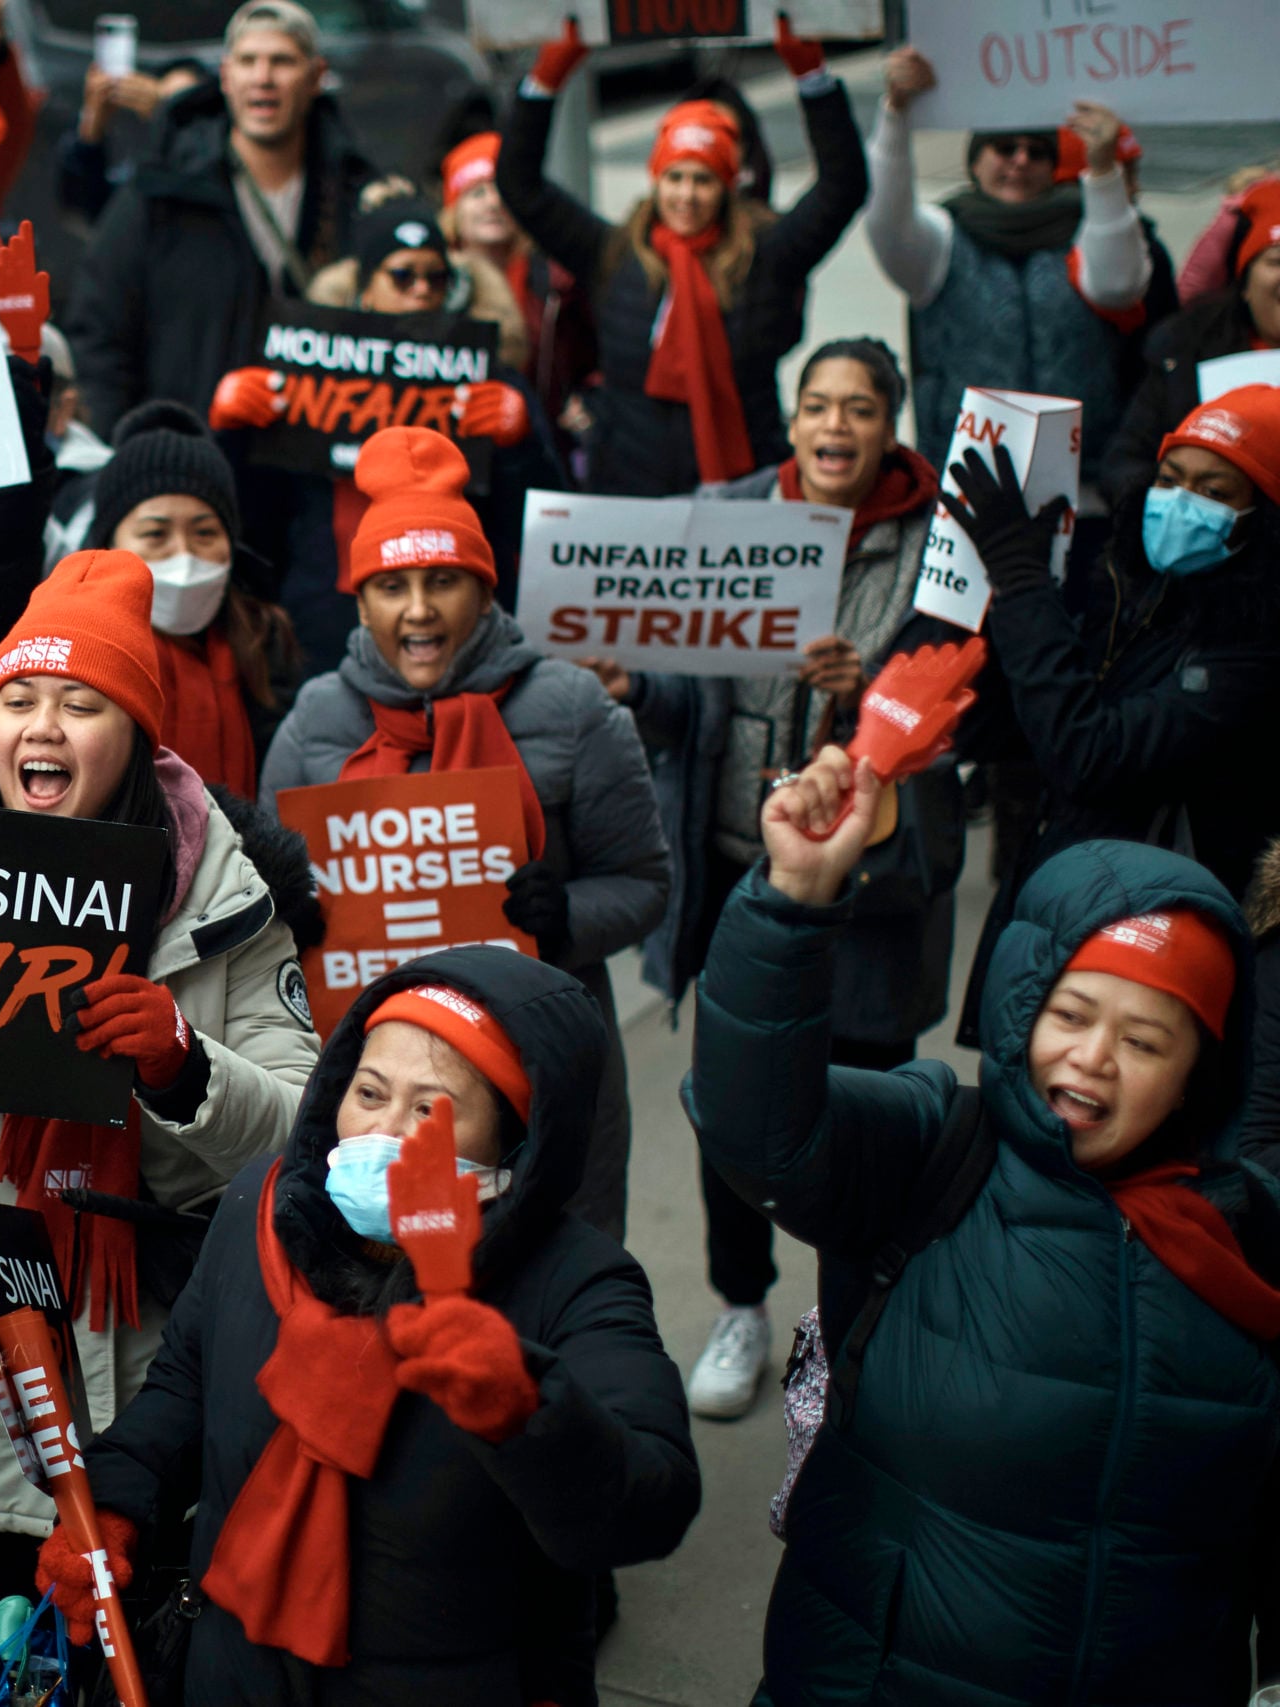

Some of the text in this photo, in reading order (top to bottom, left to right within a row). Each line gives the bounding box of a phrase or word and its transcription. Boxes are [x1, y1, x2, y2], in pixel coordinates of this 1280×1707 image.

[980, 18, 1196, 88] OUTSIDE
[265, 324, 489, 383] MOUNT SINAI
[552, 543, 823, 569] UNFAIR LABOR
[594, 576, 775, 600] PRACTICE
[548, 605, 800, 651] STRIKE
[325, 802, 479, 852] MORE
[309, 845, 516, 897] NURSES
